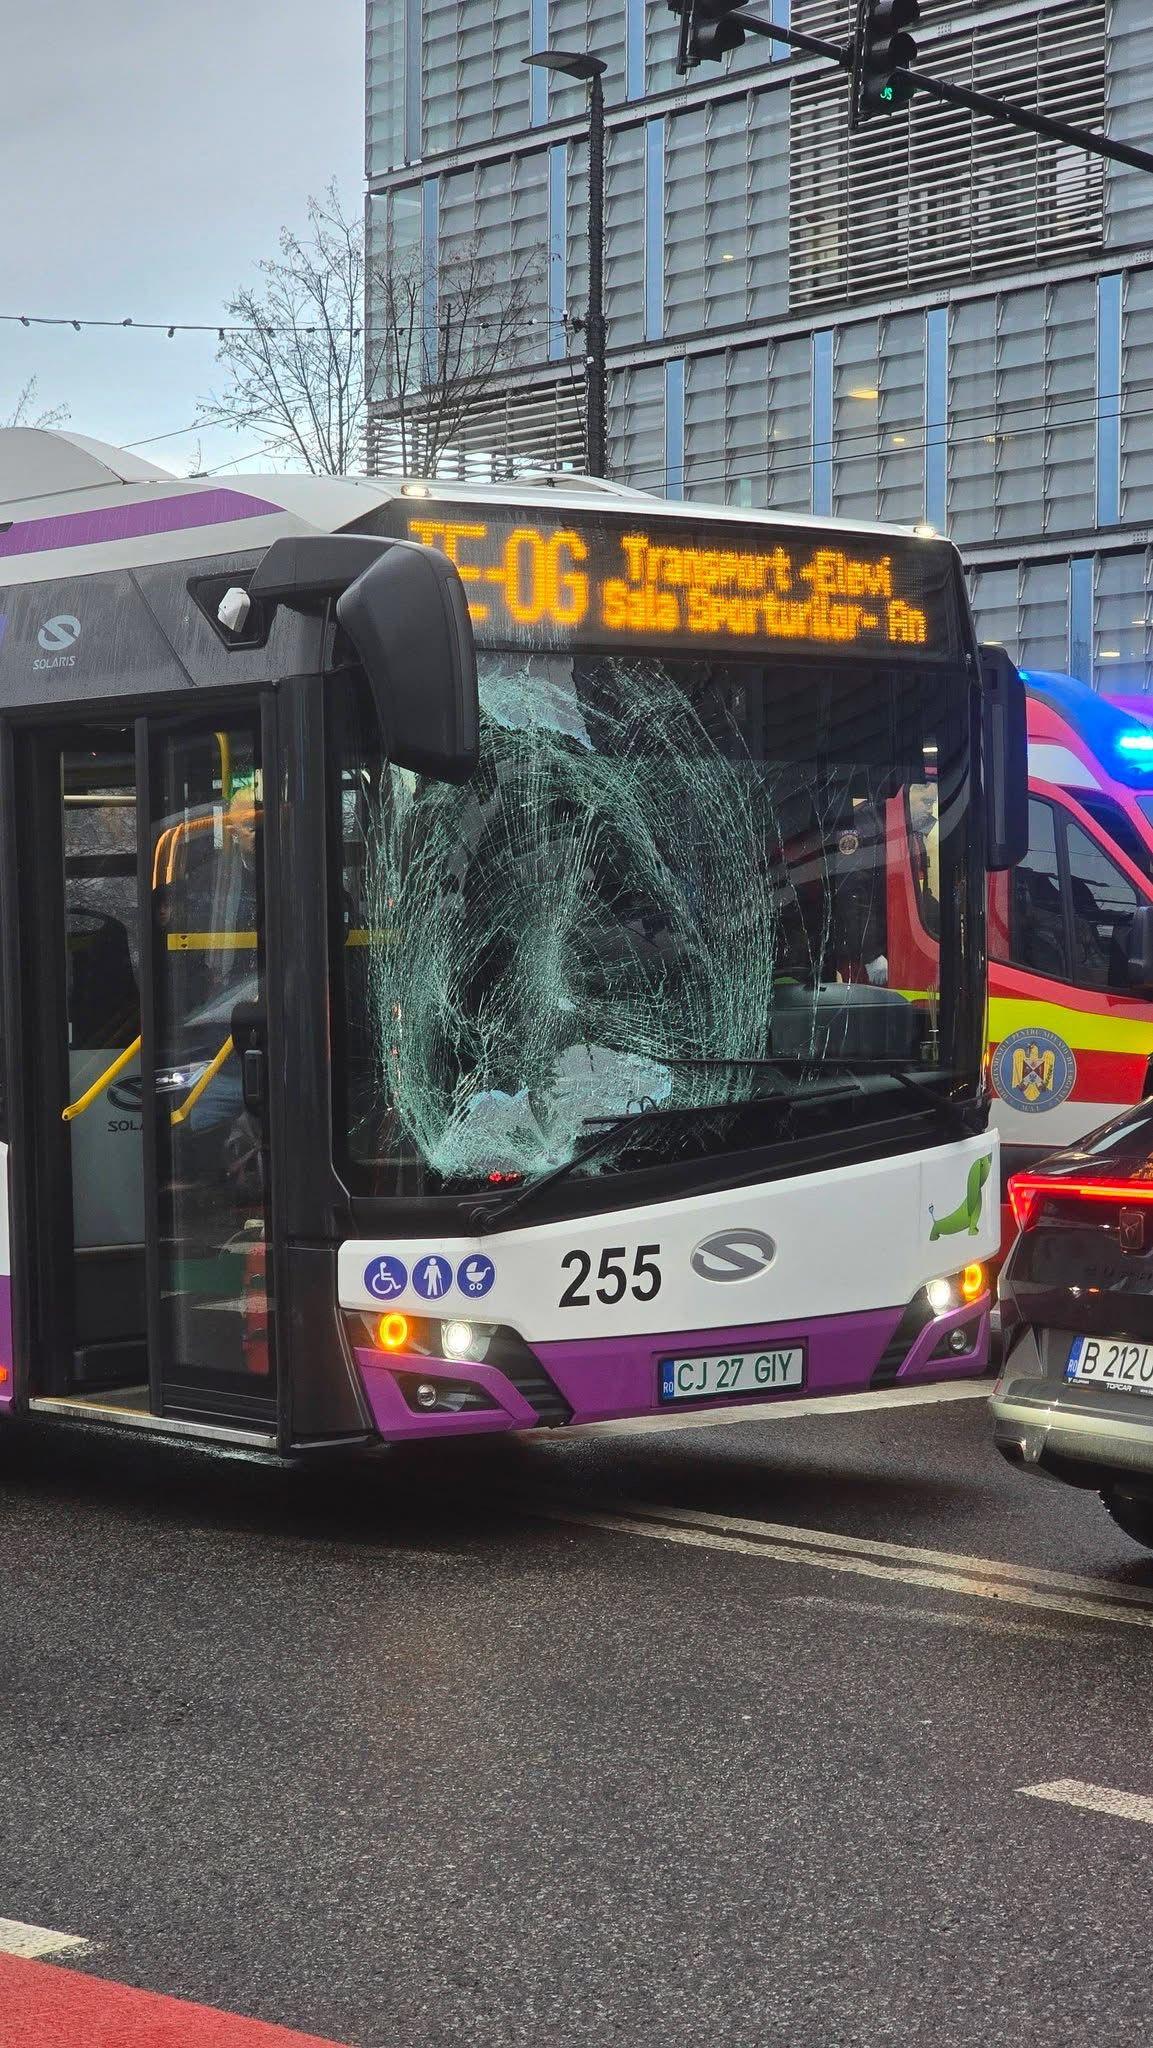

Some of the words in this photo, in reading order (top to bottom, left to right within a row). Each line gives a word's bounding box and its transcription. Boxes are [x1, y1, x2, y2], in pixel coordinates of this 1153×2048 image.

[622, 535, 792, 592] Transport
[603, 579, 679, 631] Sala
[33, 656, 76, 670] SOLARIS
[108, 1120, 144, 1132] SOL
[558, 1244, 662, 1307] 255
[677, 1362, 708, 1392] CJ
[716, 1357, 744, 1388] 27
[754, 1352, 793, 1383] GIY
[1081, 1341, 1100, 1374] B
[663, 1381, 674, 1394] RO
